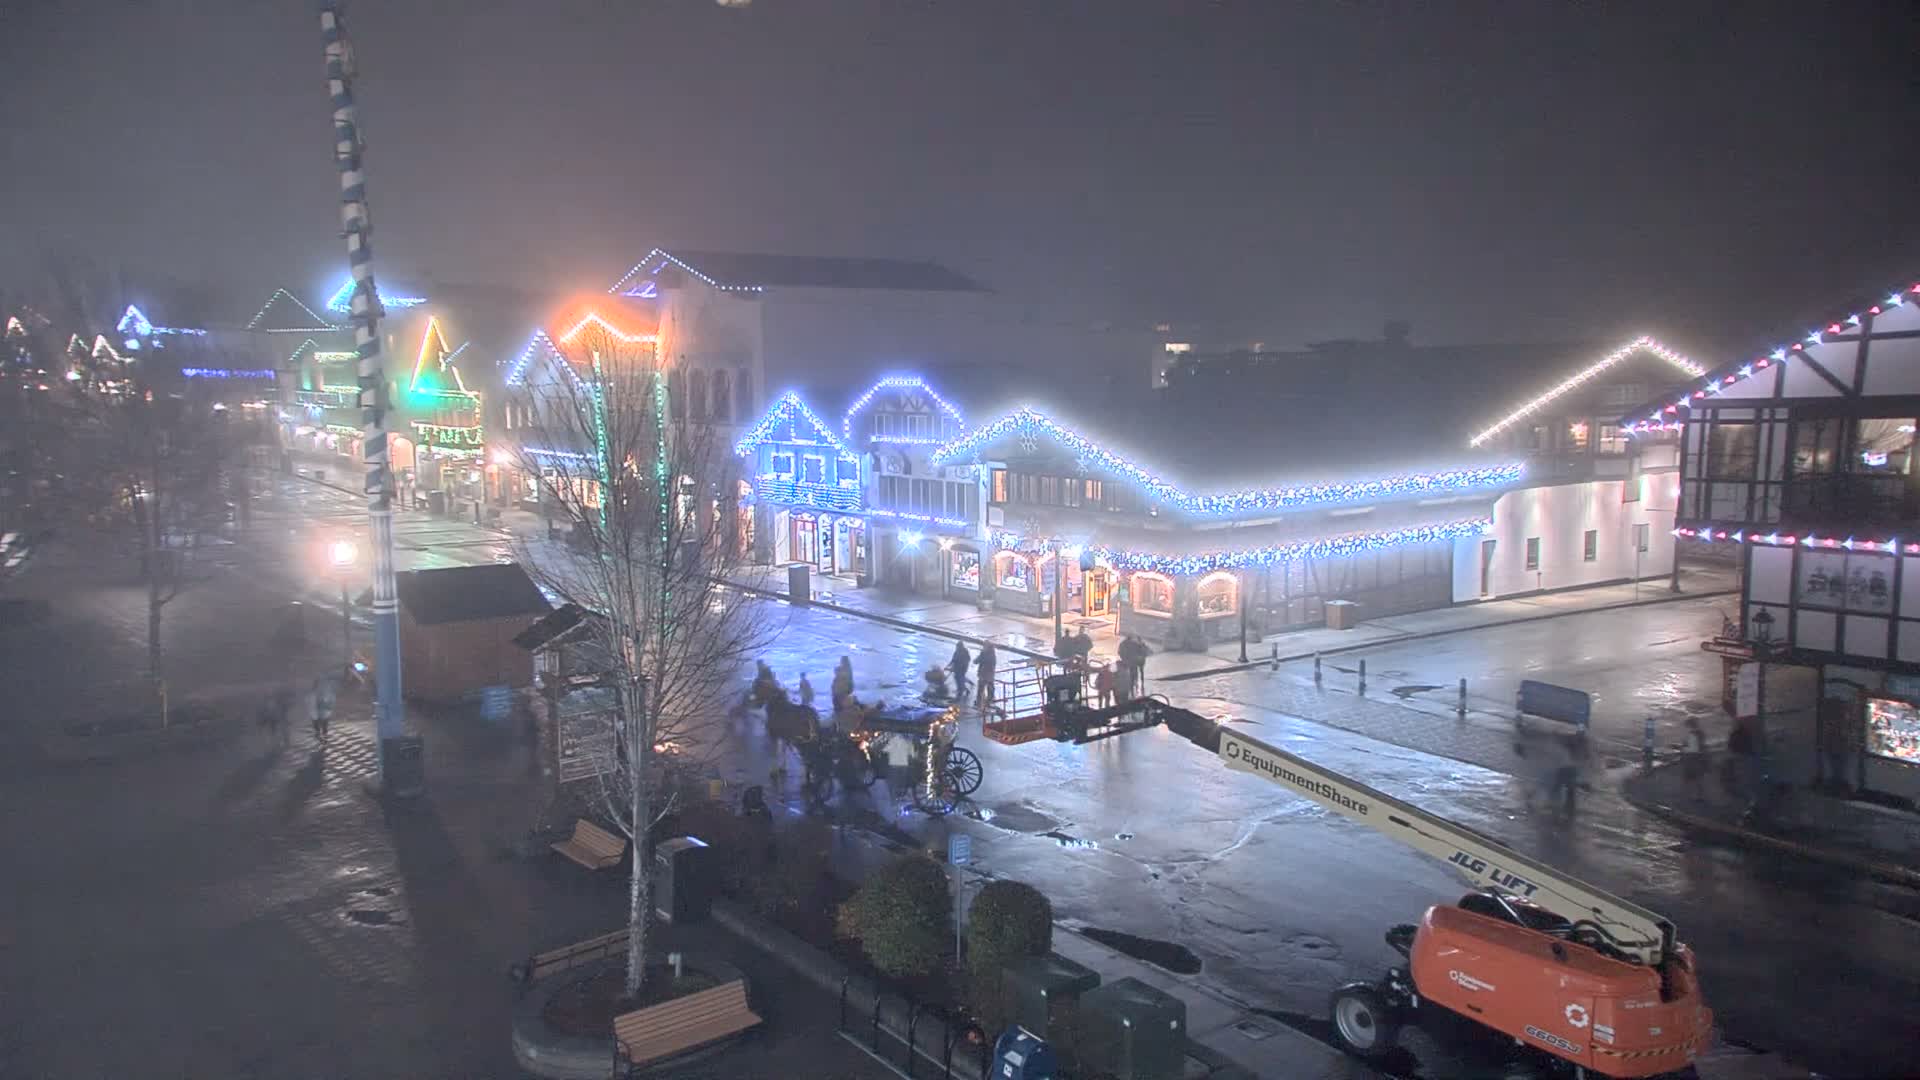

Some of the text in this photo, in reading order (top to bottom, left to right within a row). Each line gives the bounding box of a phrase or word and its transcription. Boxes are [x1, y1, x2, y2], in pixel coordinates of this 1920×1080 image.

[1242, 748, 1368, 815] EquipmentShare
[1447, 851, 1539, 897] JLG LIFT
[1525, 1025, 1583, 1054] 660SJ
